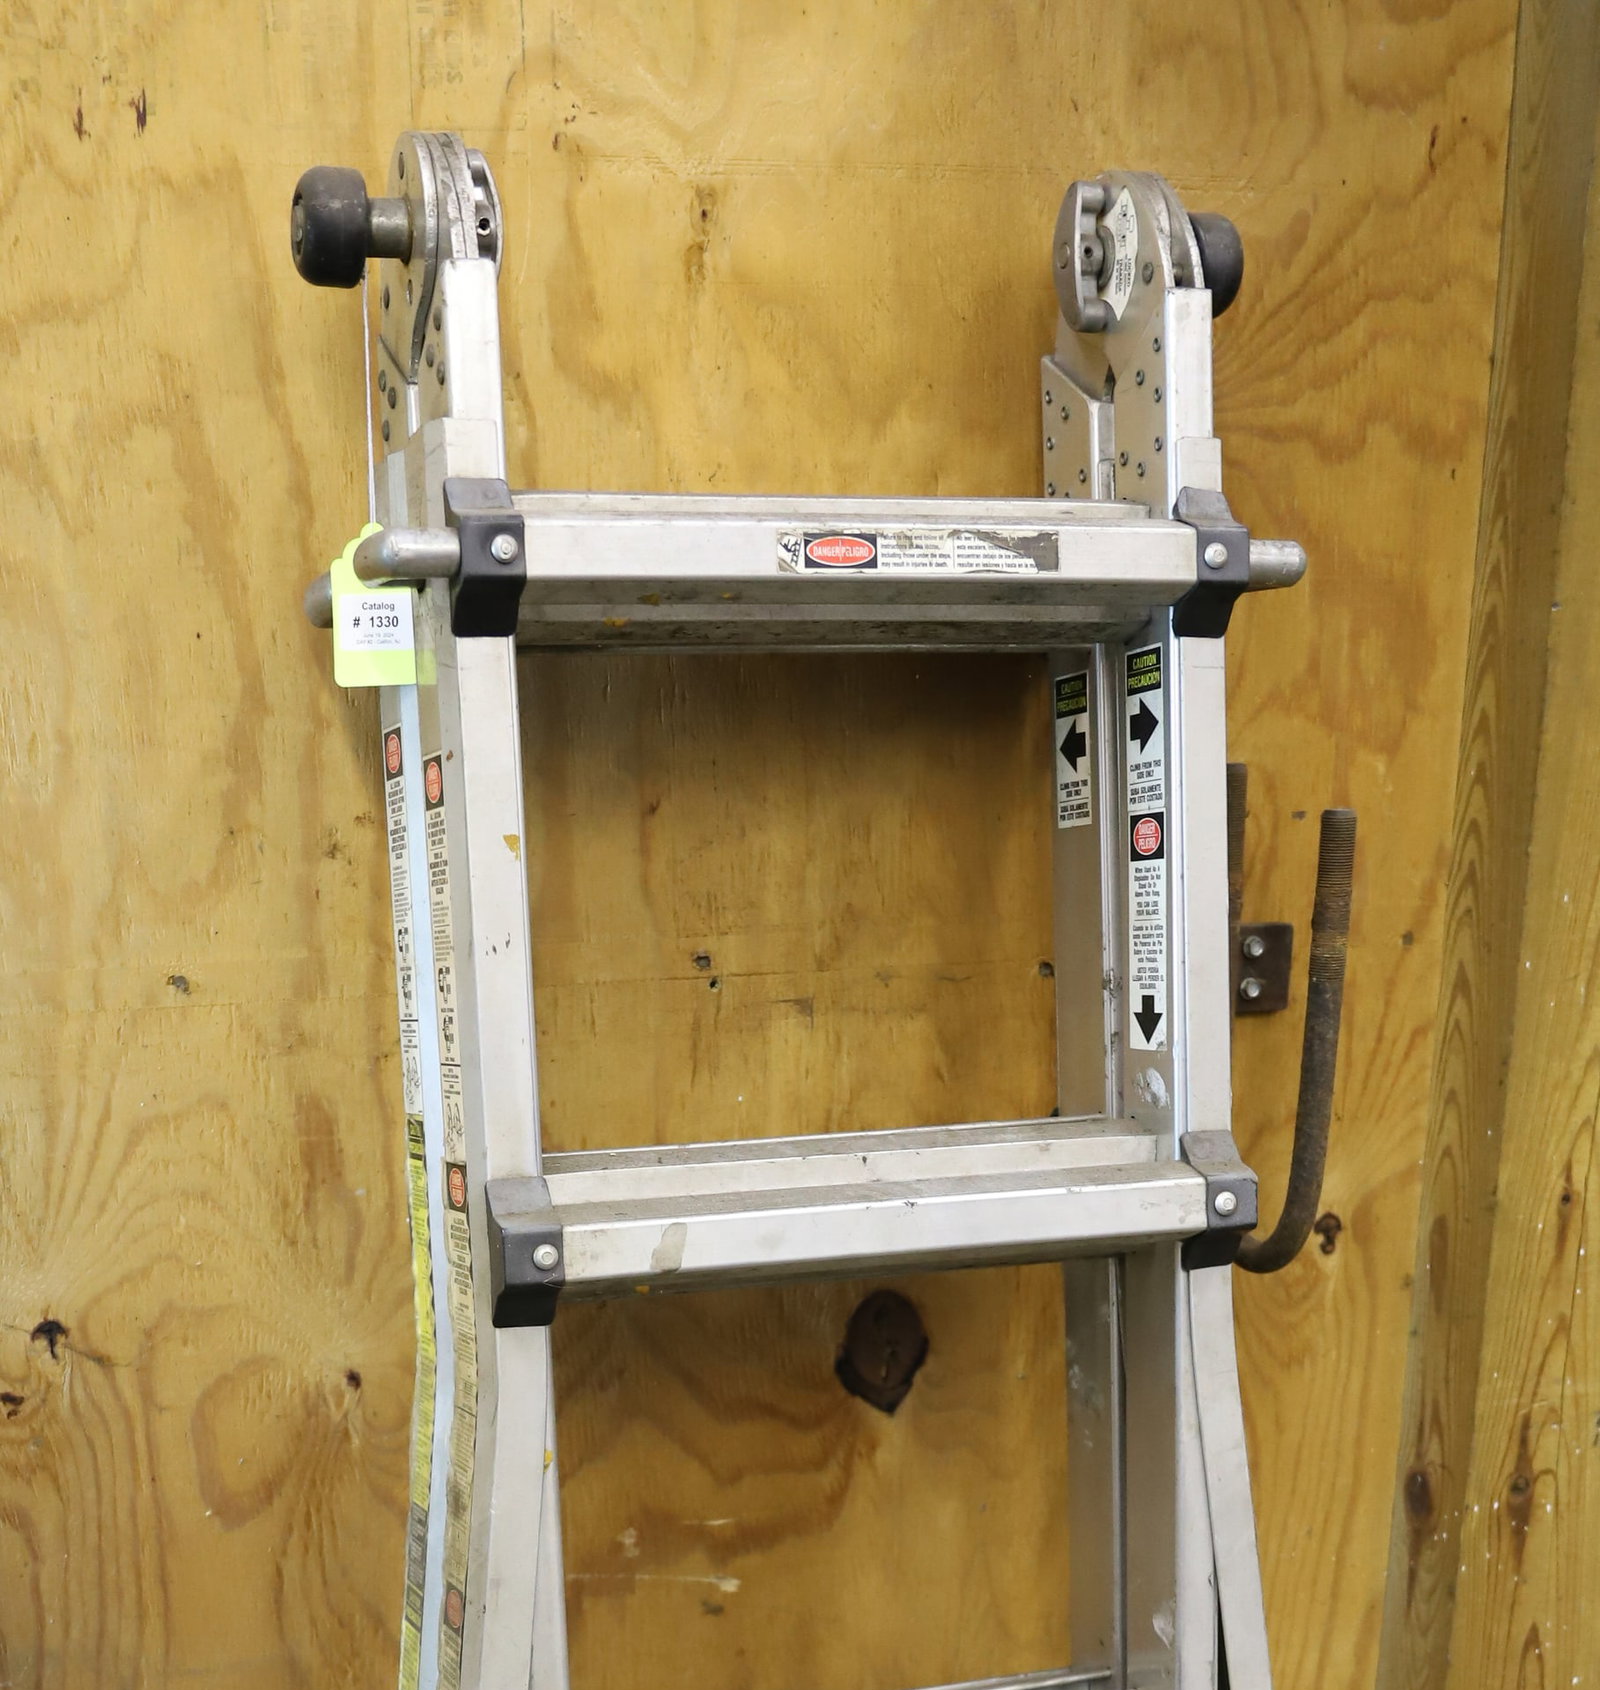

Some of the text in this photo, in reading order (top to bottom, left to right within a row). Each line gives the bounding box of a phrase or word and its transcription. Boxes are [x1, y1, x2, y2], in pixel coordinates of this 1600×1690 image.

[813, 545, 840, 557] DANGER
[362, 602, 395, 612] Catalog
[353, 616, 399, 628] # 1330
[1133, 653, 1157, 670] CAUTION
[1128, 669, 1160, 689] PRECAUCIÓN
[1142, 761, 1152, 769] FROM
[1153, 759, 1161, 767] THIS
[1145, 769, 1154, 778] ONLY
[1140, 784, 1161, 793] SOLAMENTE
[1138, 795, 1146, 803] ESTE
[1146, 792, 1162, 802] COSTADO
[1138, 822, 1156, 835] DANGER
[1151, 900, 1159, 908] LOSE
